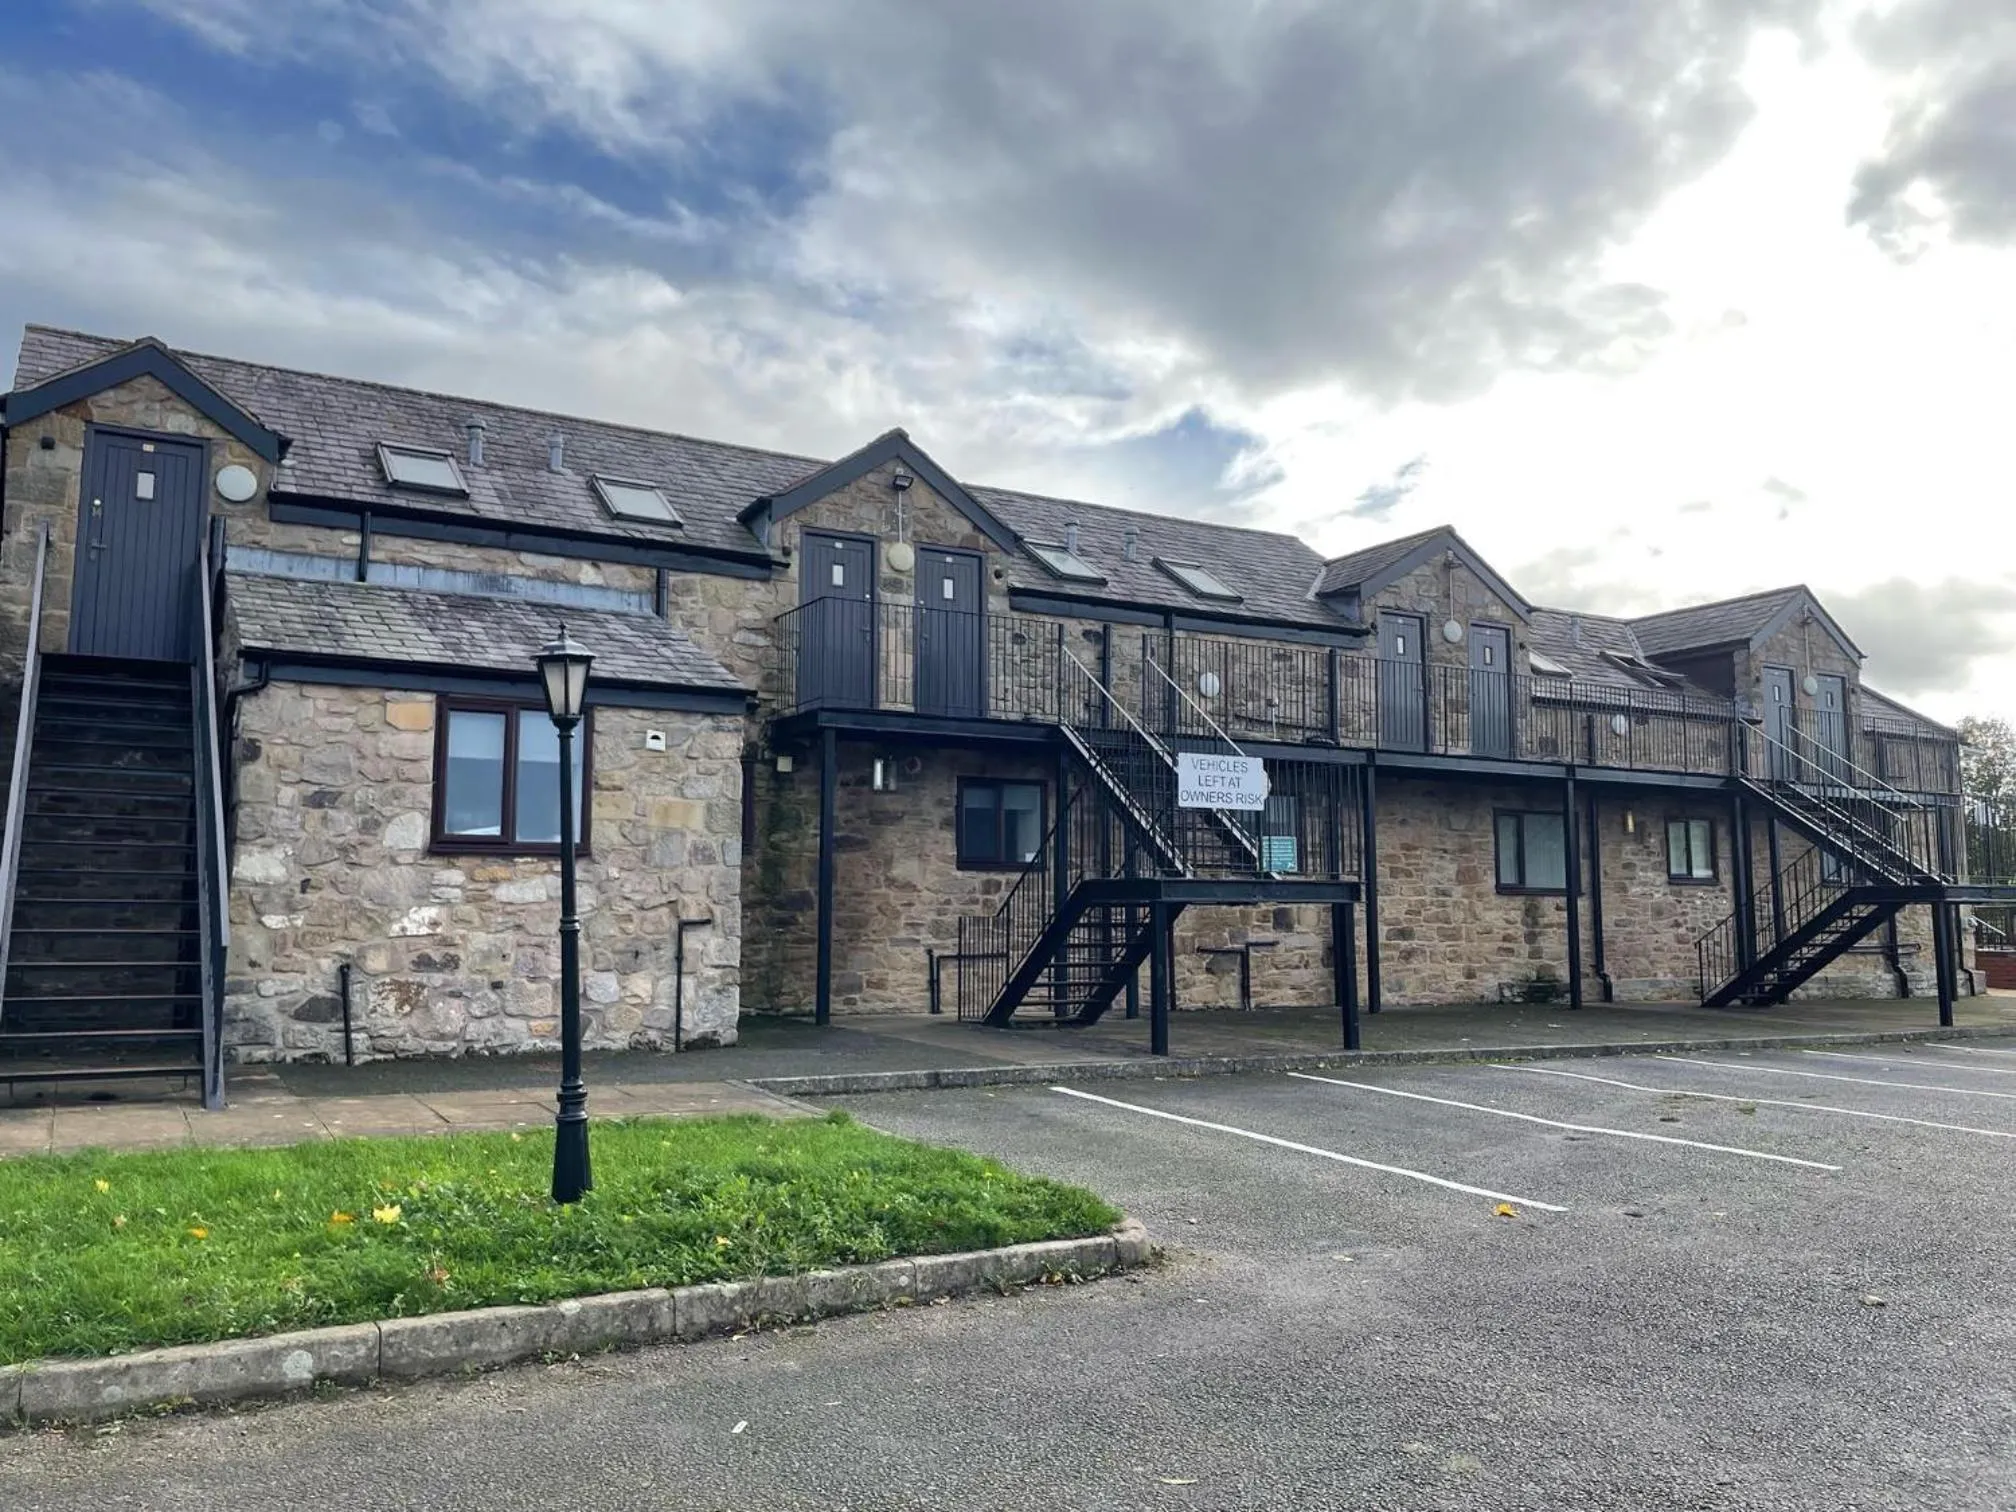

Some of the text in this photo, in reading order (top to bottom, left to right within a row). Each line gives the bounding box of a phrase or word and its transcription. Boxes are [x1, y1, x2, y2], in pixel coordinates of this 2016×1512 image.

[1191, 758, 1248, 773] VEHICLES
[1198, 775, 1241, 788] LEFT AT
[1180, 790, 1263, 805] OWNERS RISK
